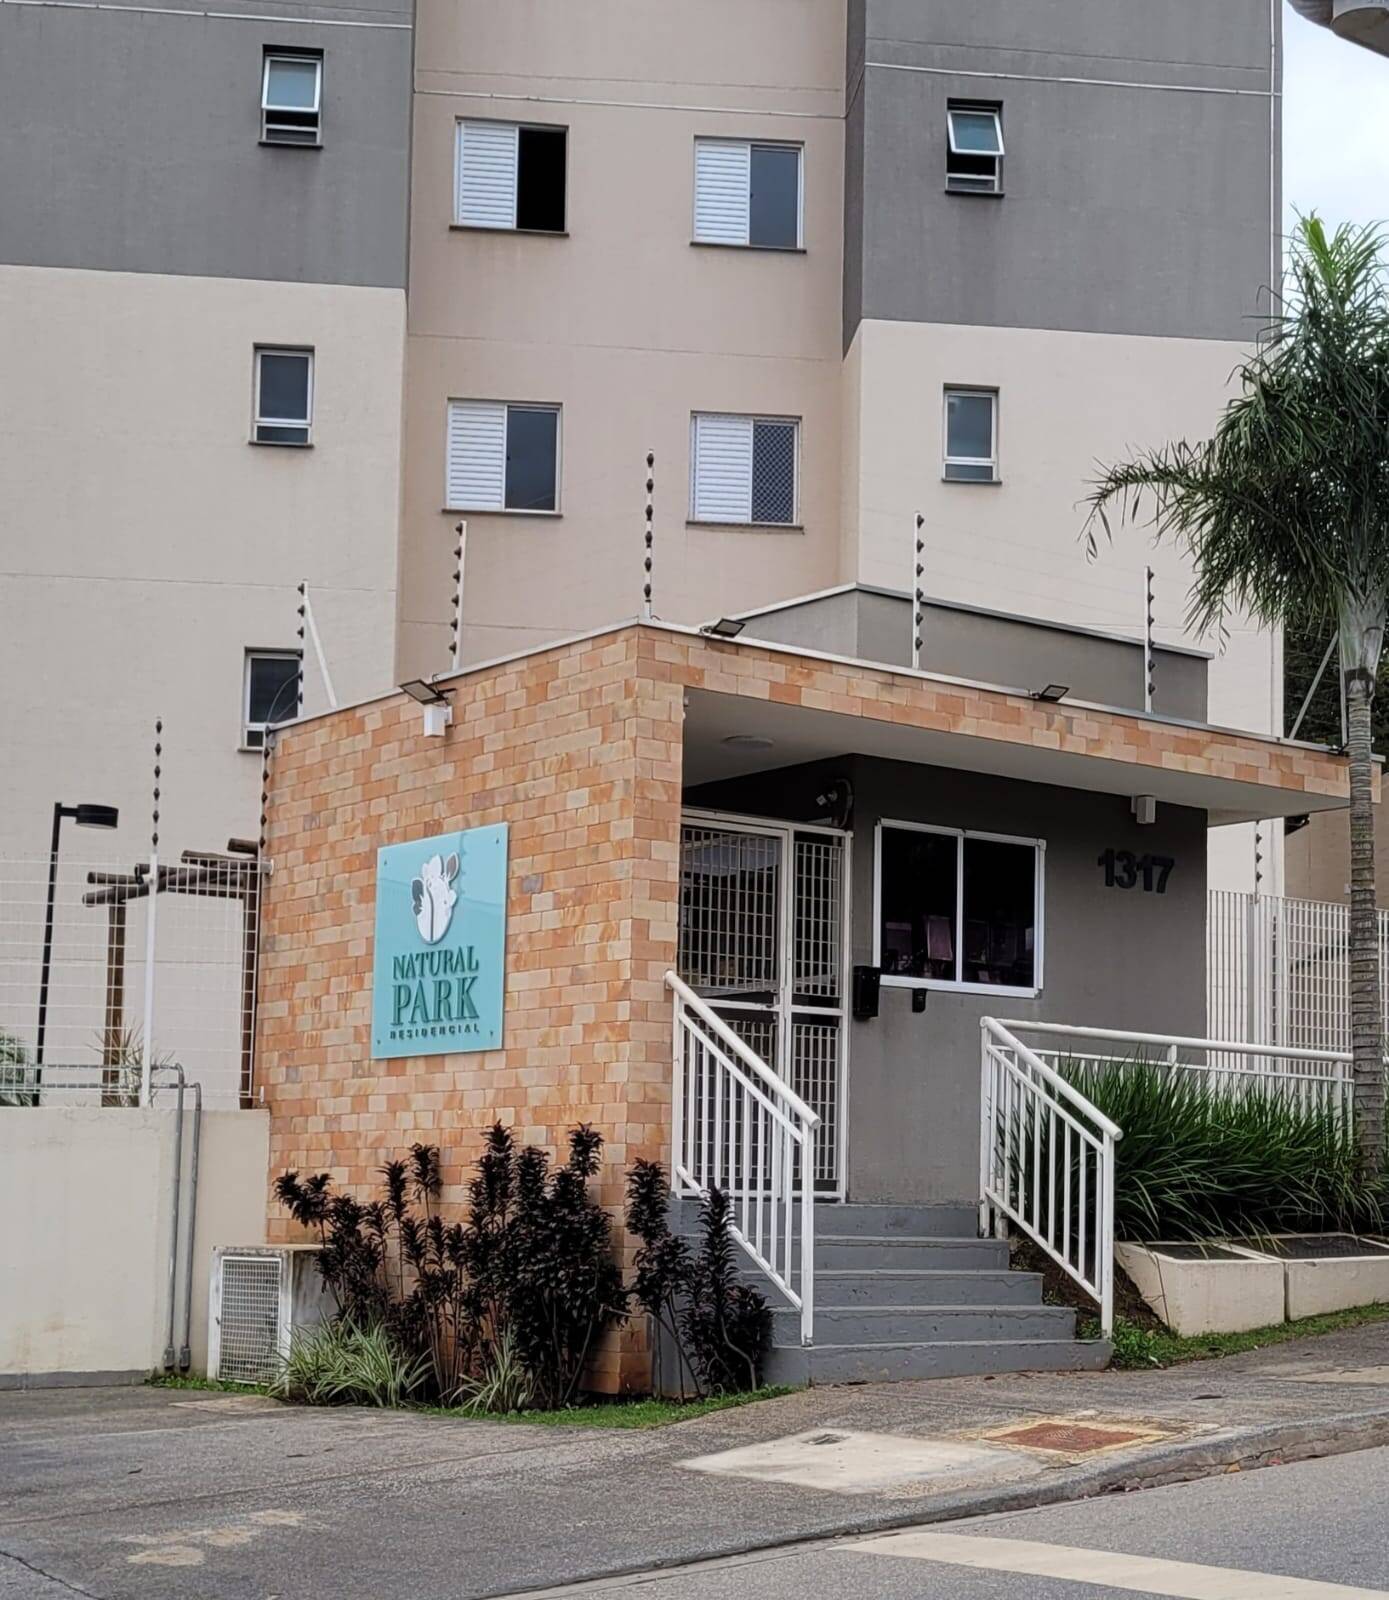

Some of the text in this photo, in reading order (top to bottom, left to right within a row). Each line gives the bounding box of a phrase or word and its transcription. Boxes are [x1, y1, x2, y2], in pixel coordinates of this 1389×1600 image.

[1097, 847, 1175, 893] 1317
[393, 946, 479, 980] NATURAL
[391, 976, 480, 1026] PARK
[390, 1023, 480, 1040] RESIDENCIAL
